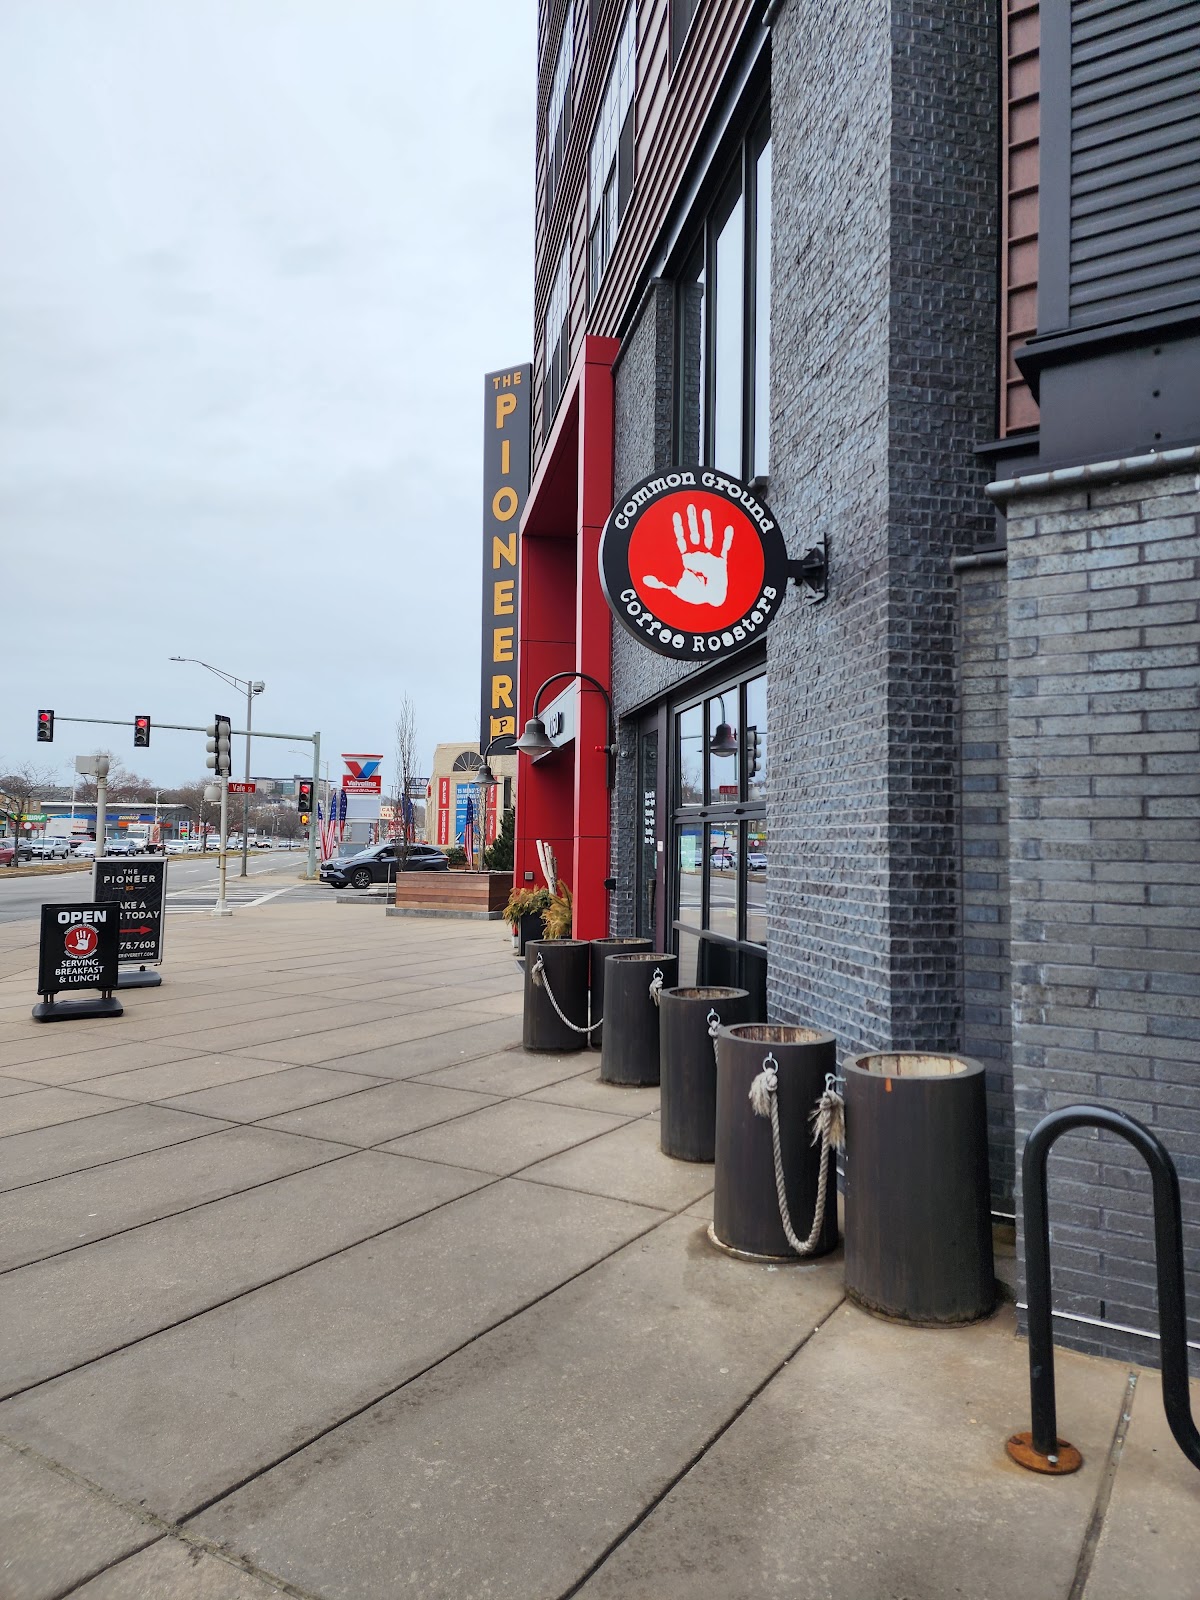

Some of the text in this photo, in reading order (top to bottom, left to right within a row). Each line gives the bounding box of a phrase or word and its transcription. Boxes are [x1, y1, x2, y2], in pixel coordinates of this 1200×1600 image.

[492, 371, 522, 389] THE
[614, 471, 775, 534] Common Ground
[491, 392, 519, 709] PIONEER
[620, 585, 777, 652] Coffee Roasters
[499, 719, 507, 732] P
[232, 783, 246, 793] Vale
[103, 875, 156, 883] PIONEER
[120, 901, 147, 909] AKE A
[57, 910, 107, 924] OPEN
[125, 911, 160, 919] TODAY
[120, 941, 156, 950] 75.7608
[61, 958, 99, 968] SERVING
[55, 965, 105, 976] BREAKFAST
[58, 973, 100, 983] & LUNCH
